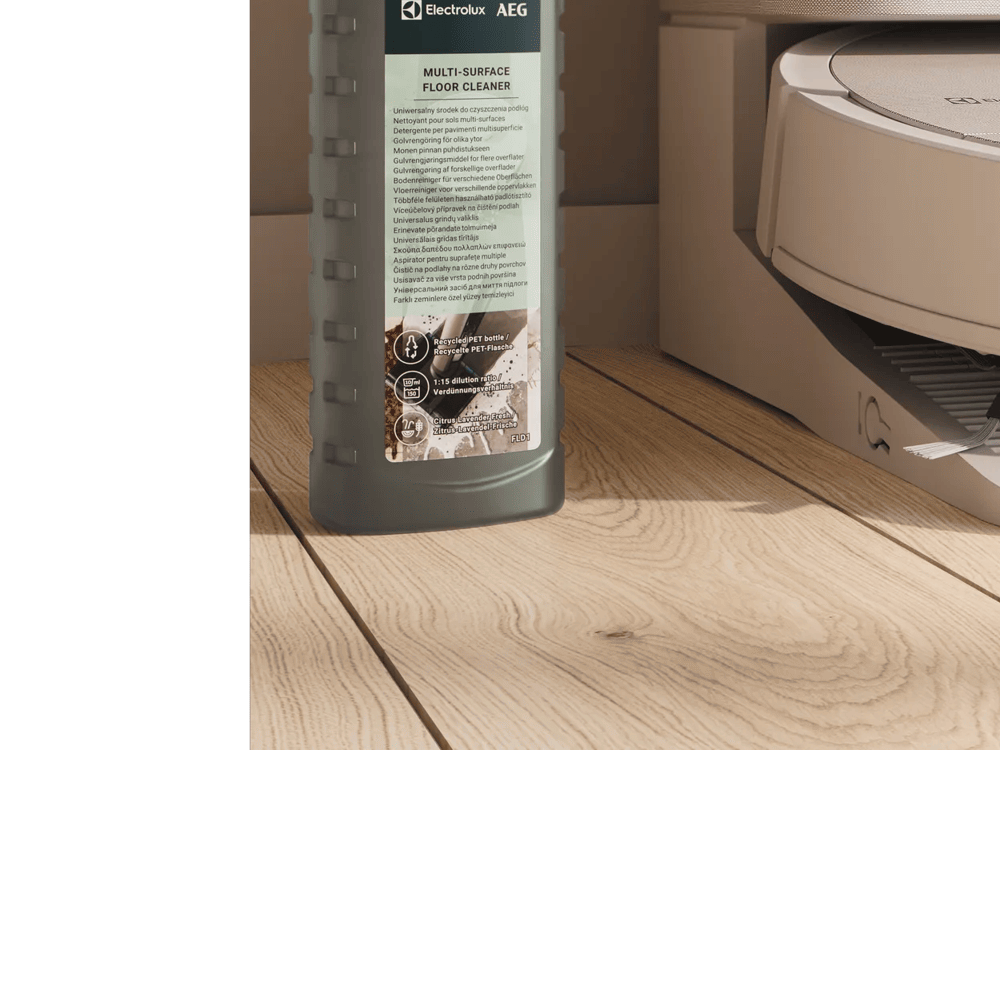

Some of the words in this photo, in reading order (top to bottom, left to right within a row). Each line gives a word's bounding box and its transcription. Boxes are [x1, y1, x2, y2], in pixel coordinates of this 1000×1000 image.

[426, 3, 486, 15] Electrolux
[496, 3, 527, 17] AEG
[423, 67, 510, 77] MULTI-SURFACE
[423, 83, 459, 92] FLOOR
[463, 82, 510, 91] CLEANER
[393, 107, 435, 115] Uniwersalny
[436, 106, 458, 114] środek
[470, 106, 507, 114] czyszczenia
[445, 126, 476, 134] pavimenti
[478, 124, 523, 132] multisuperficie
[393, 137, 441, 145] Golvrengöring
[443, 146, 490, 154] puhdistukseen
[393, 156, 469, 165] Gulvrengjøringsmiddel
[453, 174, 495, 182] verschiedene
[497, 183, 536, 191] oppervlakken
[455, 194, 494, 202] használható
[495, 192, 532, 200] padlótisztító
[393, 216, 433, 224] Universalus
[435, 216, 456, 224] grindų
[393, 266, 414, 274] Čistič
[424, 265, 451, 273] podlahy
[449, 283, 467, 291] засіб
[462, 293, 481, 301] yüzey
[482, 291, 514, 299] temizleyici
[434, 337, 467, 346] Recycled
[484, 334, 504, 342] bottle
[434, 348, 470, 356] Recycelte
[471, 344, 514, 352] PET-Flasche
[433, 384, 514, 395] Verdünnungsverhältnis
[433, 417, 456, 425] Citrus
[458, 414, 490, 423] Lavender
[491, 412, 509, 420] Fresh
[511, 433, 530, 443] FLD1
